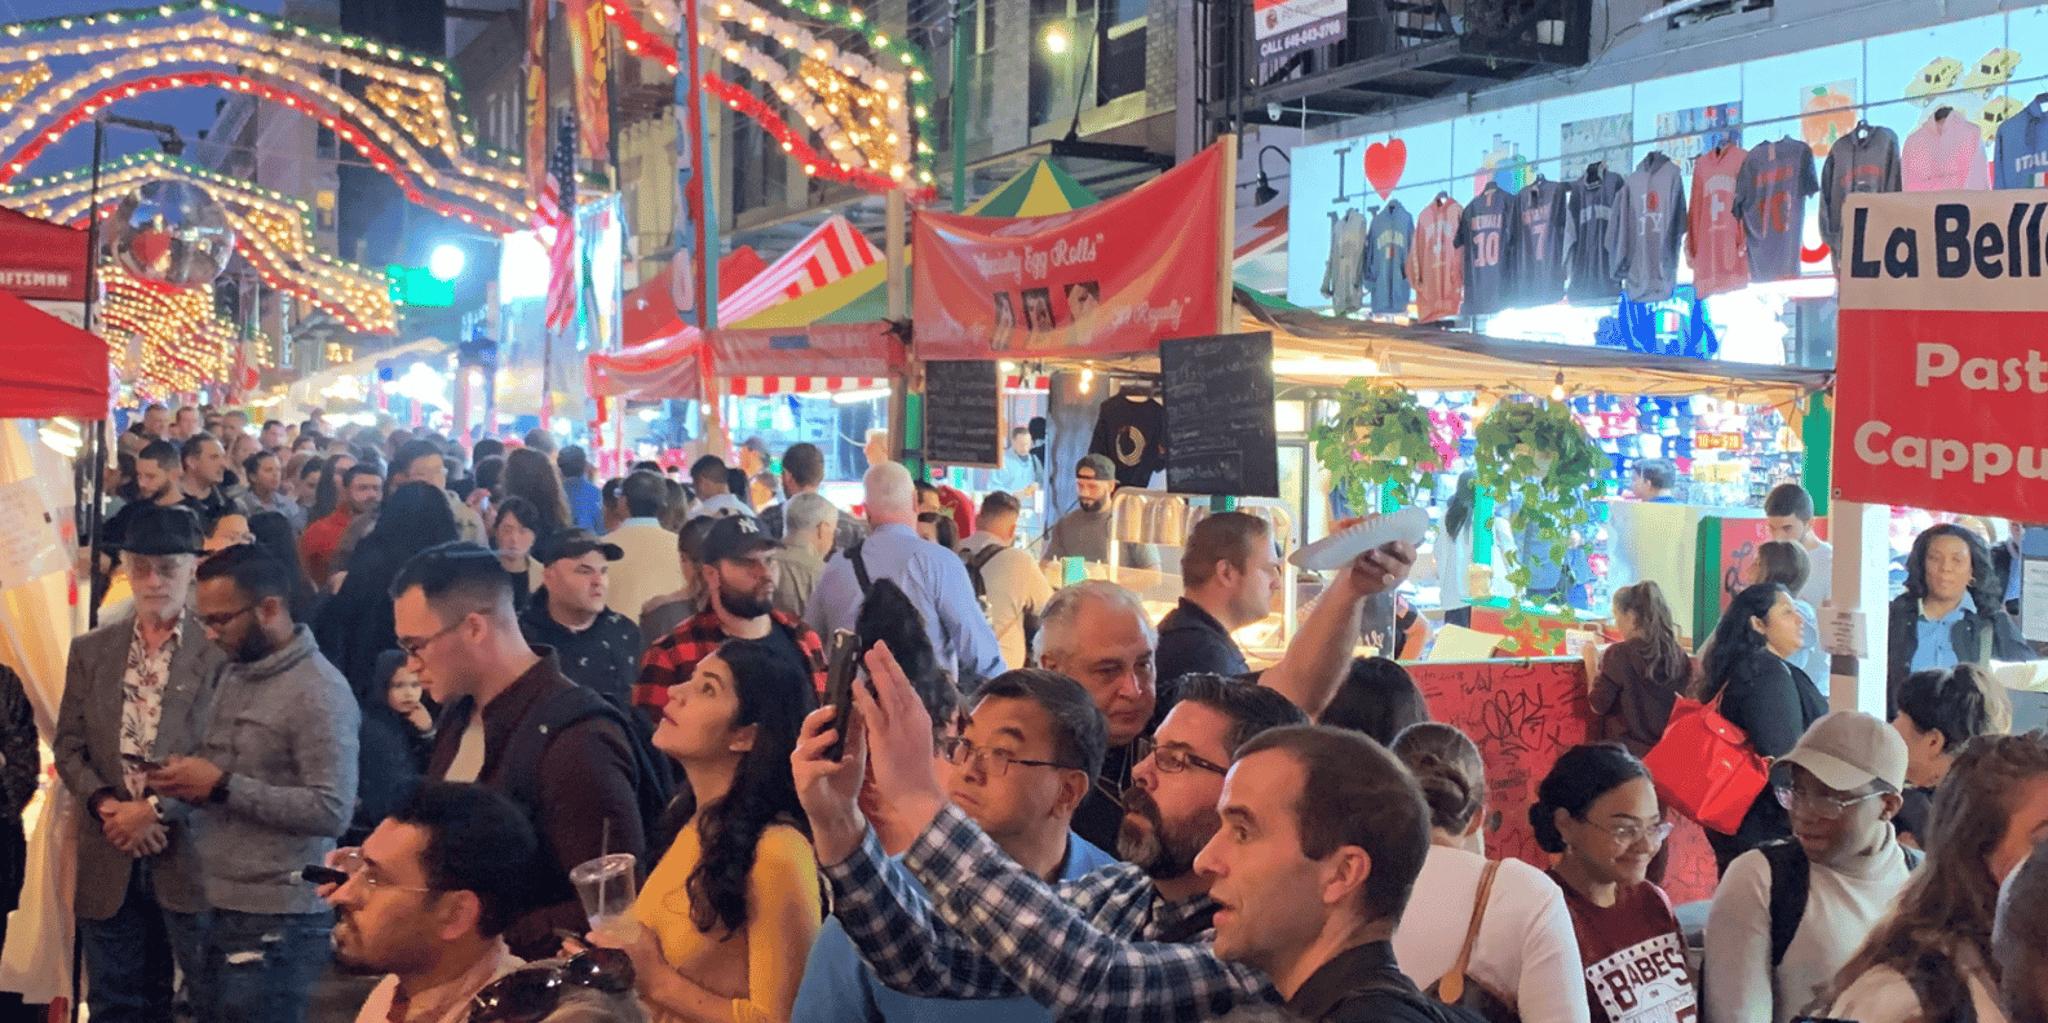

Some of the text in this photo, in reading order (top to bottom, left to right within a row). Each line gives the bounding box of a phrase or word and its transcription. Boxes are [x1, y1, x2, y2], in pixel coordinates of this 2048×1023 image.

[1260, 38, 1284, 57] CALL
[1024, 245, 1048, 280] Egg
[1472, 231, 1500, 267] 10
[1851, 202, 2048, 279] La Bell
[1916, 342, 2048, 394] Past
[1854, 420, 2048, 484] Cappu
[738, 517, 760, 534] NY
[1603, 947, 1688, 1012] BABES
